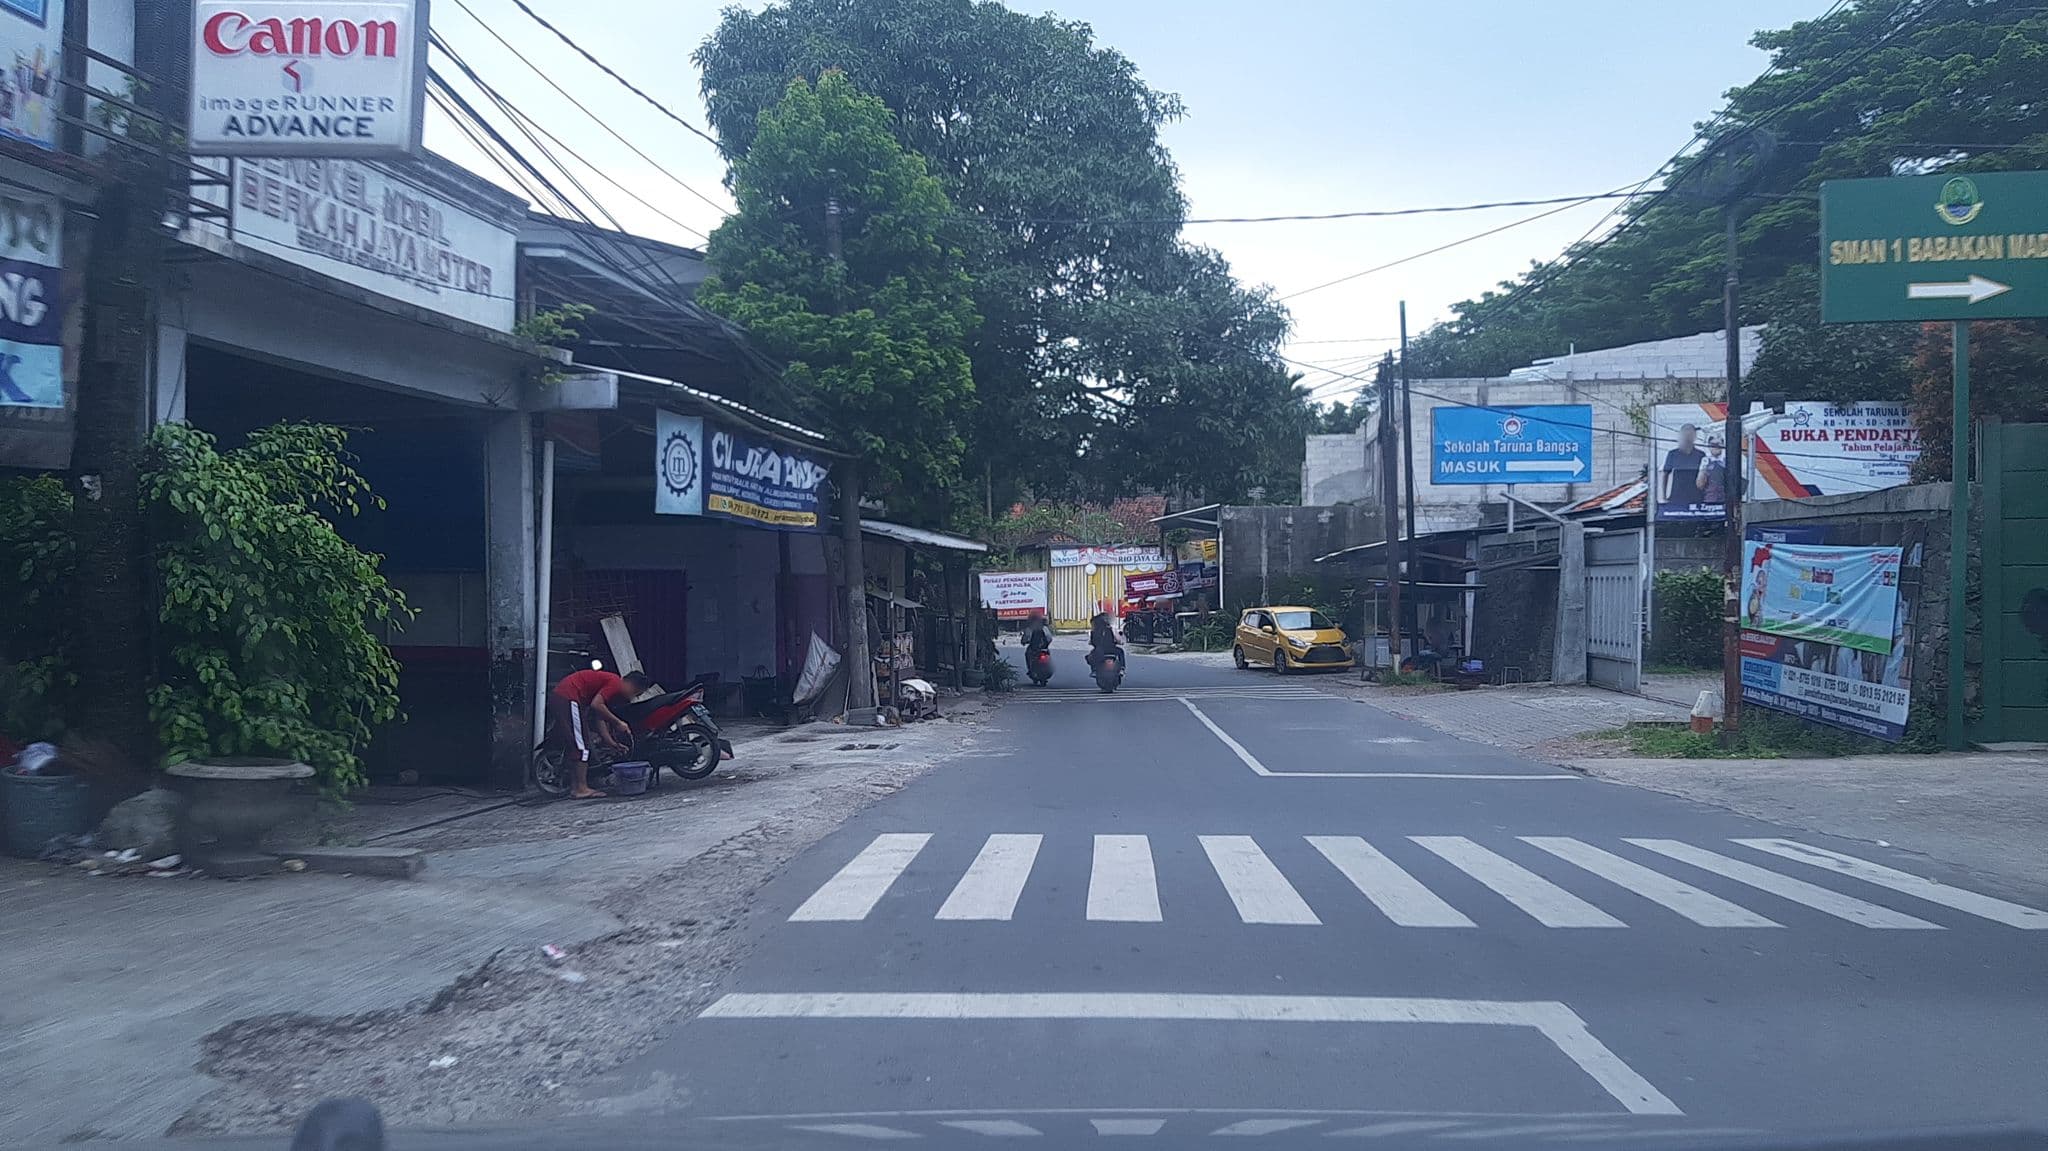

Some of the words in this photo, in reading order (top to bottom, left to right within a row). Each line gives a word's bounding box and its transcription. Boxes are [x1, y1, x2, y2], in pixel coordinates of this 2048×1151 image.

[203, 11, 397, 57] Canon
[201, 95, 395, 113] imageRUNNER
[223, 115, 375, 138] ADVANCE
[1830, 239, 1887, 265] SMAN
[1891, 238, 1902, 262] 1
[1907, 235, 2004, 262] BABAKAN
[1823, 408, 1863, 417] SEKOLAH
[1865, 408, 1899, 417] TARUNA
[1780, 429, 1830, 442] BUKA
[1444, 440, 1490, 454] Sekolah
[1494, 440, 1533, 453] Taruna
[1536, 439, 1579, 455] Bangsa
[1841, 443, 1872, 452] Tahun
[1440, 461, 1501, 473] MASUK
